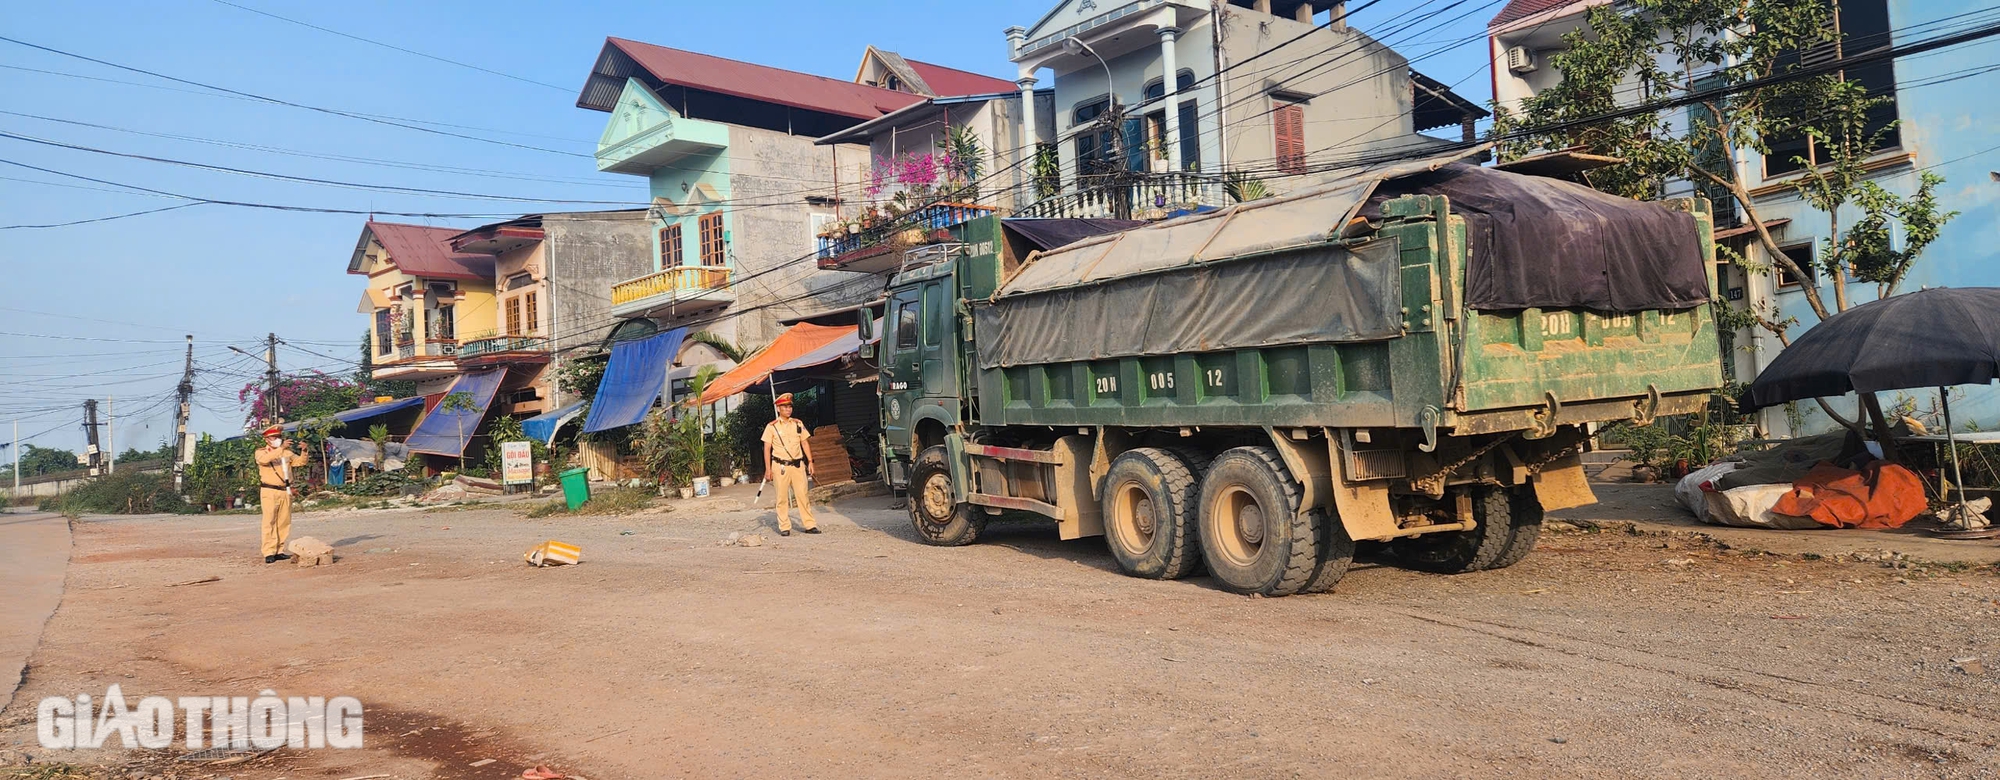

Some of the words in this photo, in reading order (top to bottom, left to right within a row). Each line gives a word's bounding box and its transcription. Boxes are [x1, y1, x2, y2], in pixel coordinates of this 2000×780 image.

[1730, 289, 1741, 299] 147
[1096, 376, 1117, 393] 20H
[1150, 372, 1174, 390] 005
[1207, 369, 1222, 386] 12
